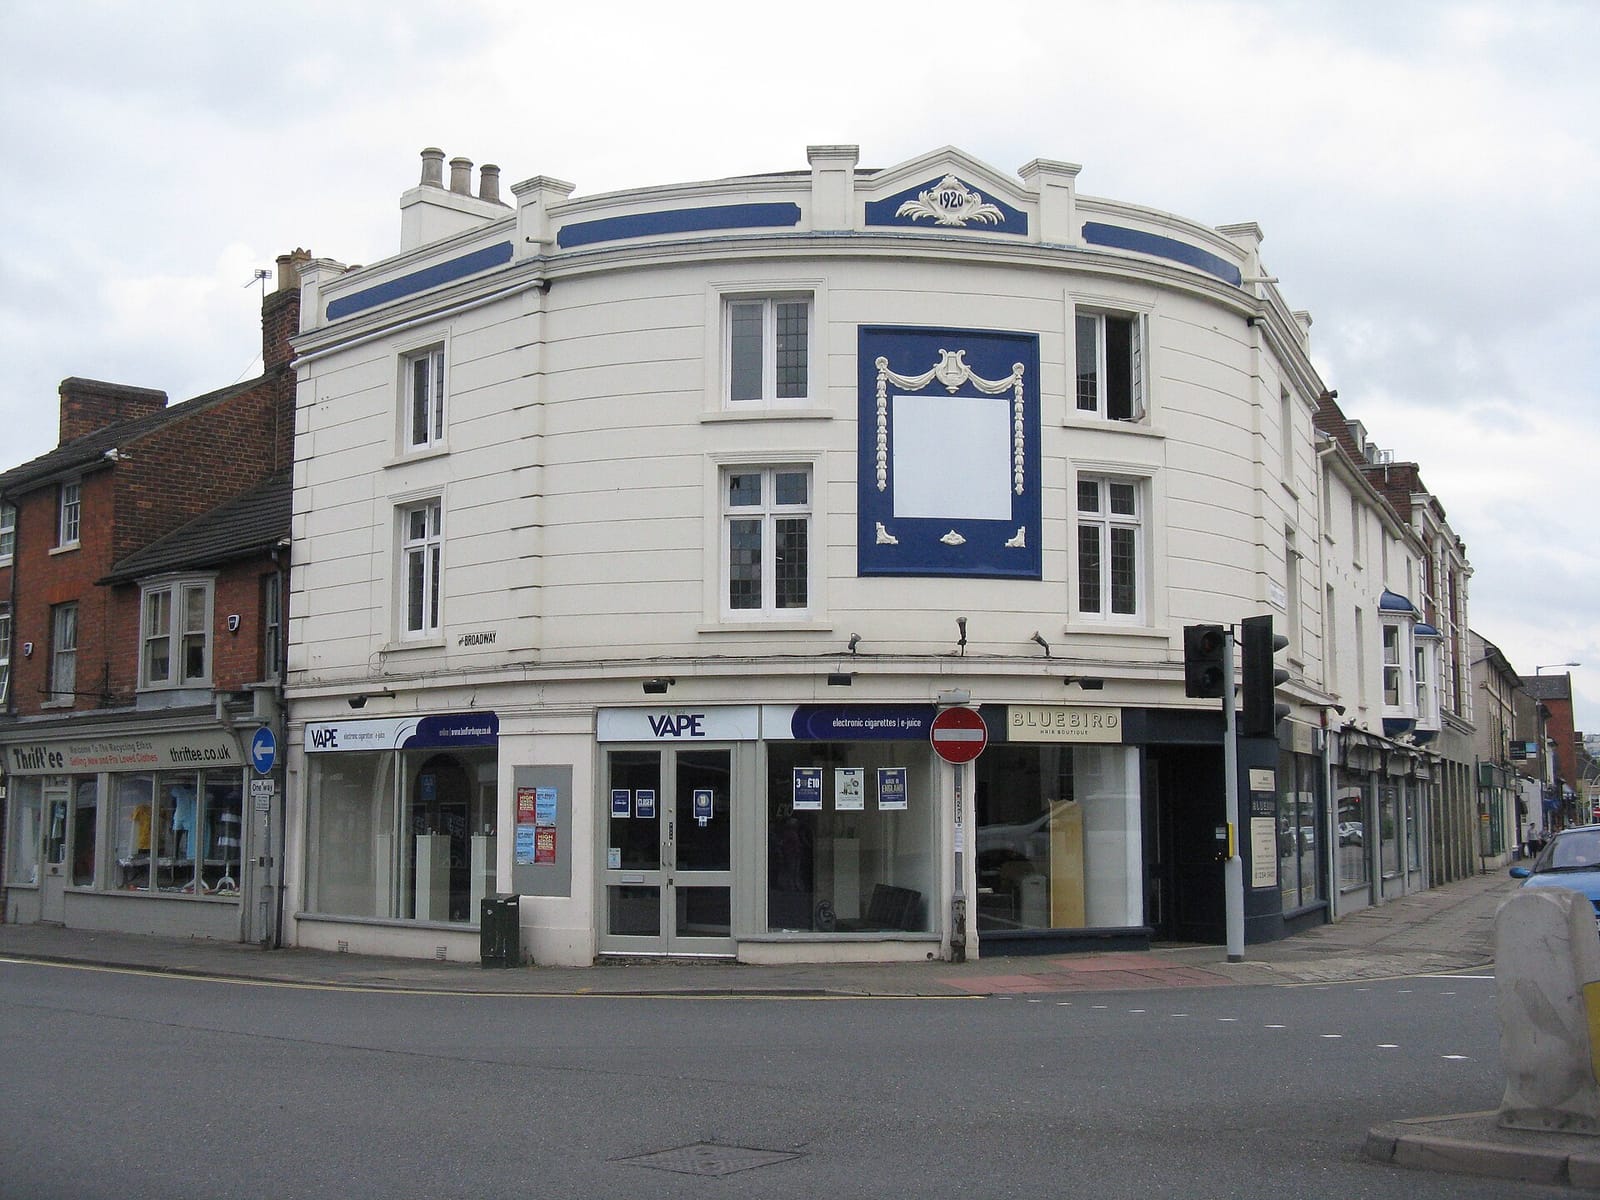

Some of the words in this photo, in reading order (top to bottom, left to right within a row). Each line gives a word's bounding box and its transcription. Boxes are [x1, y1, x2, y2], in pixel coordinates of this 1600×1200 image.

[939, 191, 964, 209] 1920
[464, 632, 497, 646] BROADWAY
[646, 714, 706, 737] VAPE
[832, 717, 864, 728] electronic
[864, 717, 897, 729] cigarettes
[900, 717, 922, 729] e-juice
[1013, 712, 1118, 728] BLUEBIRD
[311, 728, 338, 748] VAPE
[170, 744, 231, 762] thriftee.co.uk
[252, 784, 262, 792] One
[796, 778, 801, 788] 3
